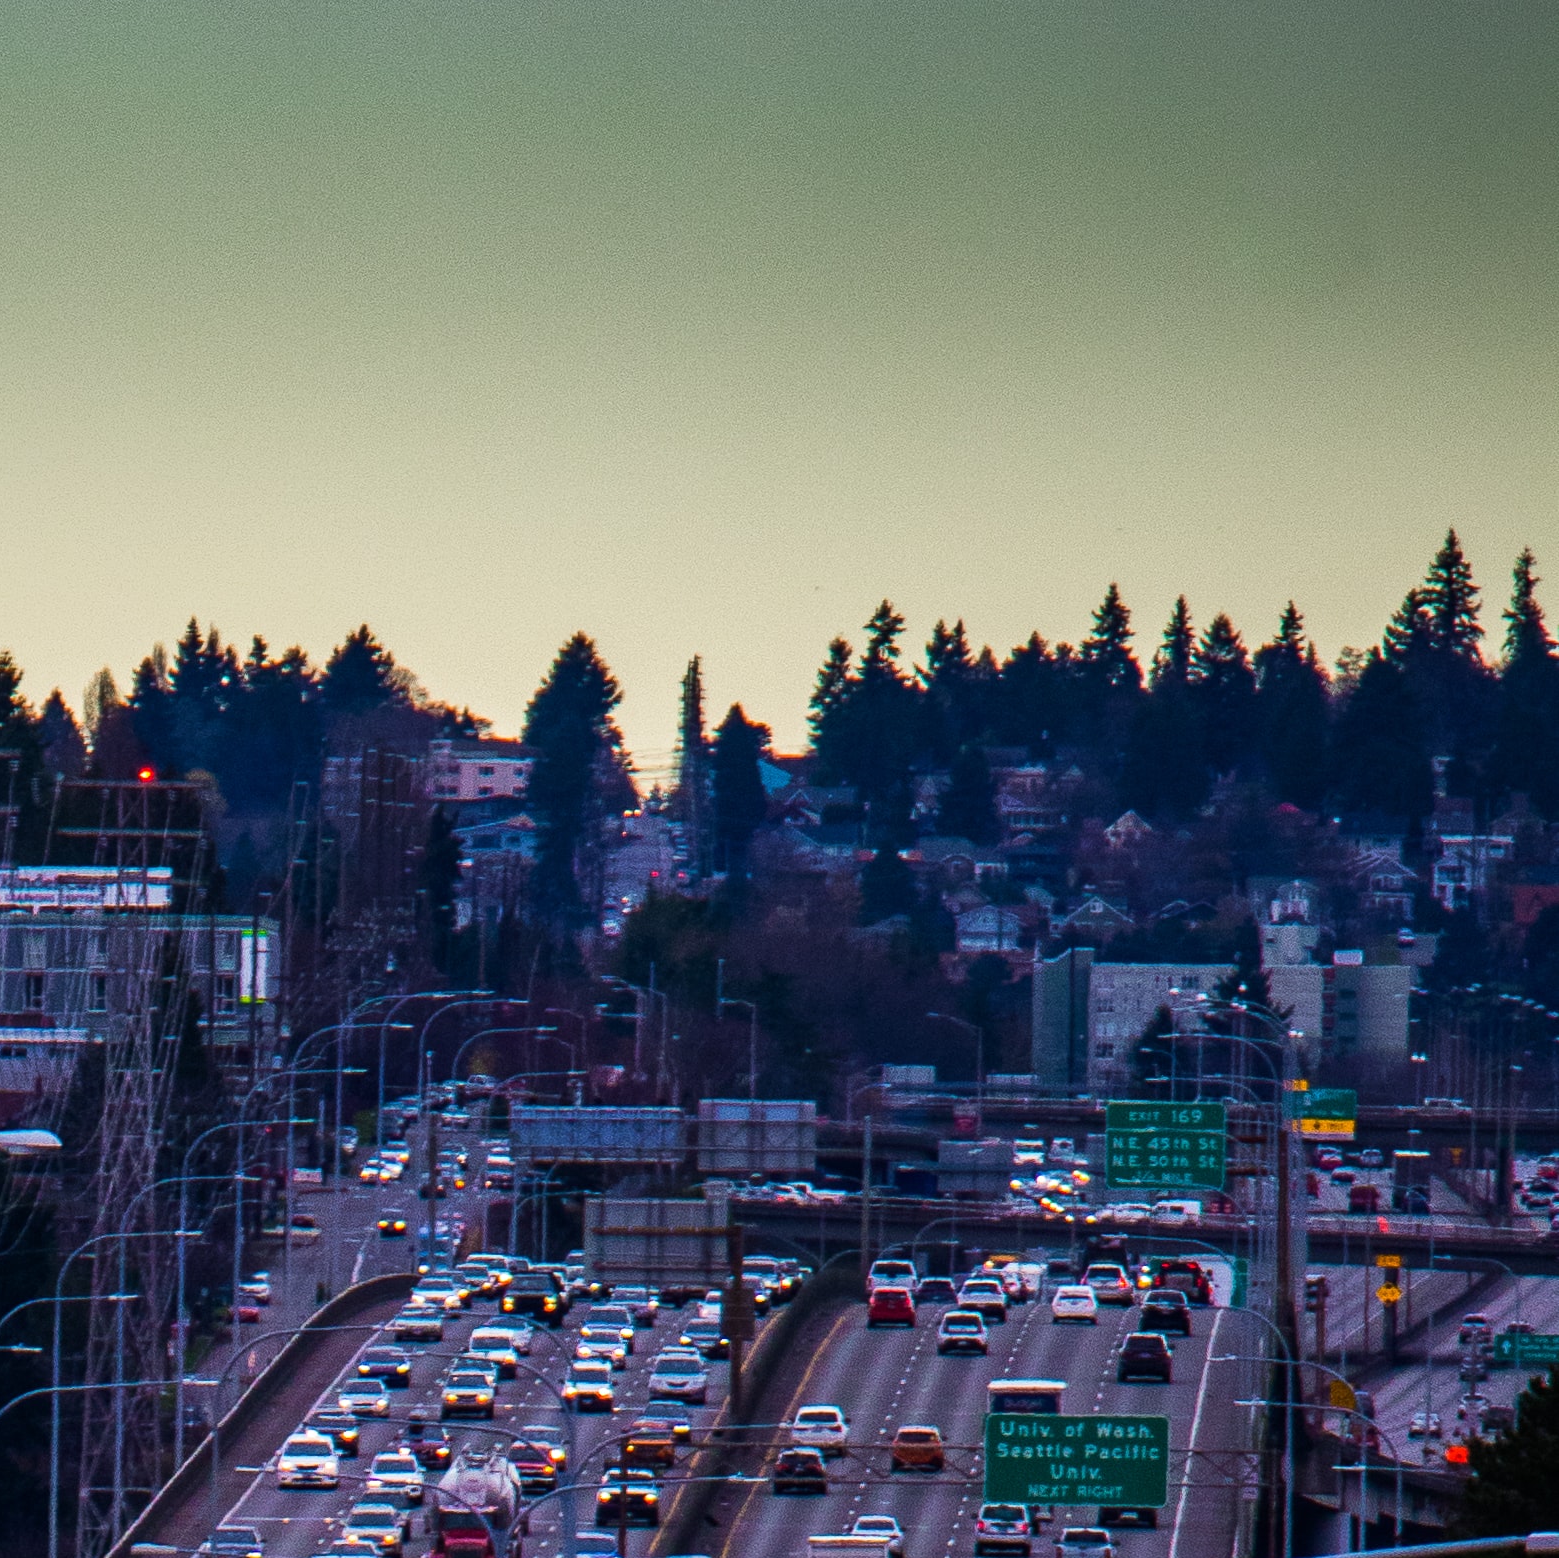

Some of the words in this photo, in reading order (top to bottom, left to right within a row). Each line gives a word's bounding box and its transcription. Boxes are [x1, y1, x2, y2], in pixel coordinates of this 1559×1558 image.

[1128, 1111, 1160, 1121] EXIT
[1172, 1109, 1202, 1122] 169
[1147, 1137, 1190, 1150] 45th
[1149, 1155, 1189, 1167] 50th
[999, 1421, 1054, 1438] Univ.
[1065, 1422, 1086, 1437] of
[1097, 1422, 1155, 1438] Wash.
[997, 1443, 1073, 1459] Seattle
[1084, 1444, 1160, 1460] Pacific
[1027, 1485, 1069, 1498] NEXT
[1077, 1485, 1123, 1498] RIGHT
